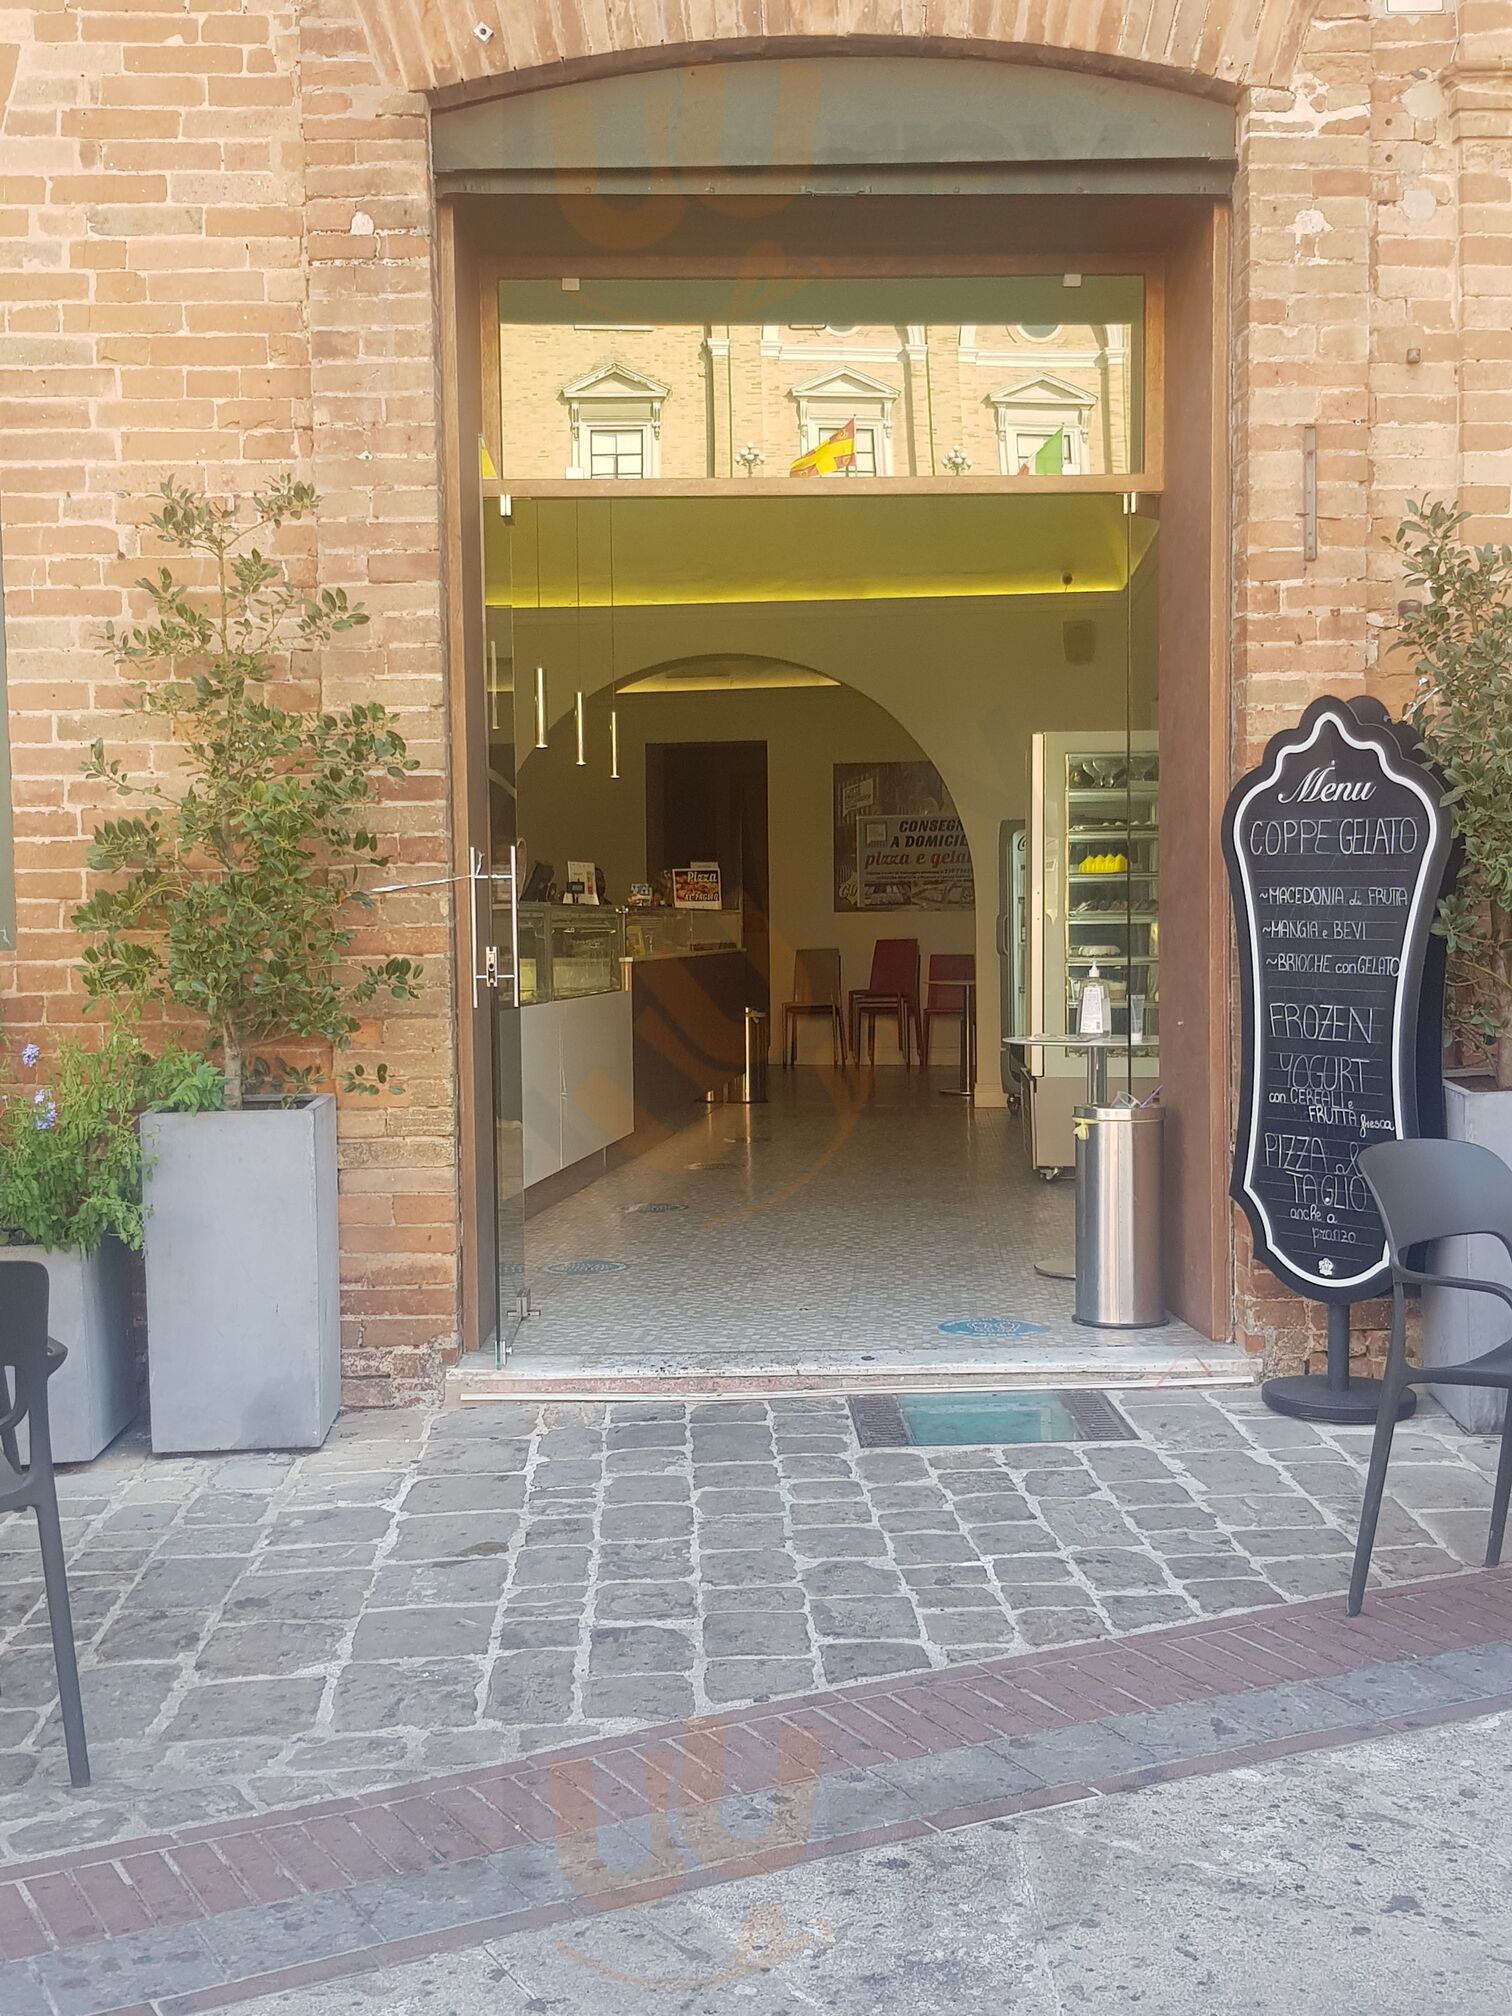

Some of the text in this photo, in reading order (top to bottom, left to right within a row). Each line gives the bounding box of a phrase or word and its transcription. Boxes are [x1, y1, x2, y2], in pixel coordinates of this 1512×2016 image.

[1277, 760, 1377, 803] Menu
[890, 835, 900, 849] A
[1250, 817, 1418, 856] COPPE GELATO
[864, 851, 911, 869] pizza
[916, 853, 925, 865] e
[1349, 890, 1362, 906] di
[1368, 887, 1408, 906] FRUTTA
[1322, 929, 1328, 939] e
[1333, 920, 1366, 940] BEVI
[1335, 962, 1357, 974] con
[1357, 955, 1400, 977] GELATO
[1269, 1002, 1373, 1044] FROZEN
[1279, 1053, 1370, 1093] YOGURT
[1268, 1087, 1354, 1110] con CEREALI e
[1308, 1105, 1395, 1138] FRUTTA fresca
[1264, 1132, 1329, 1174] PIZZA
[1285, 1170, 1367, 1212] TAGLIO
[1290, 1203, 1338, 1224] anche a
[1311, 1227, 1357, 1249] pranzo
